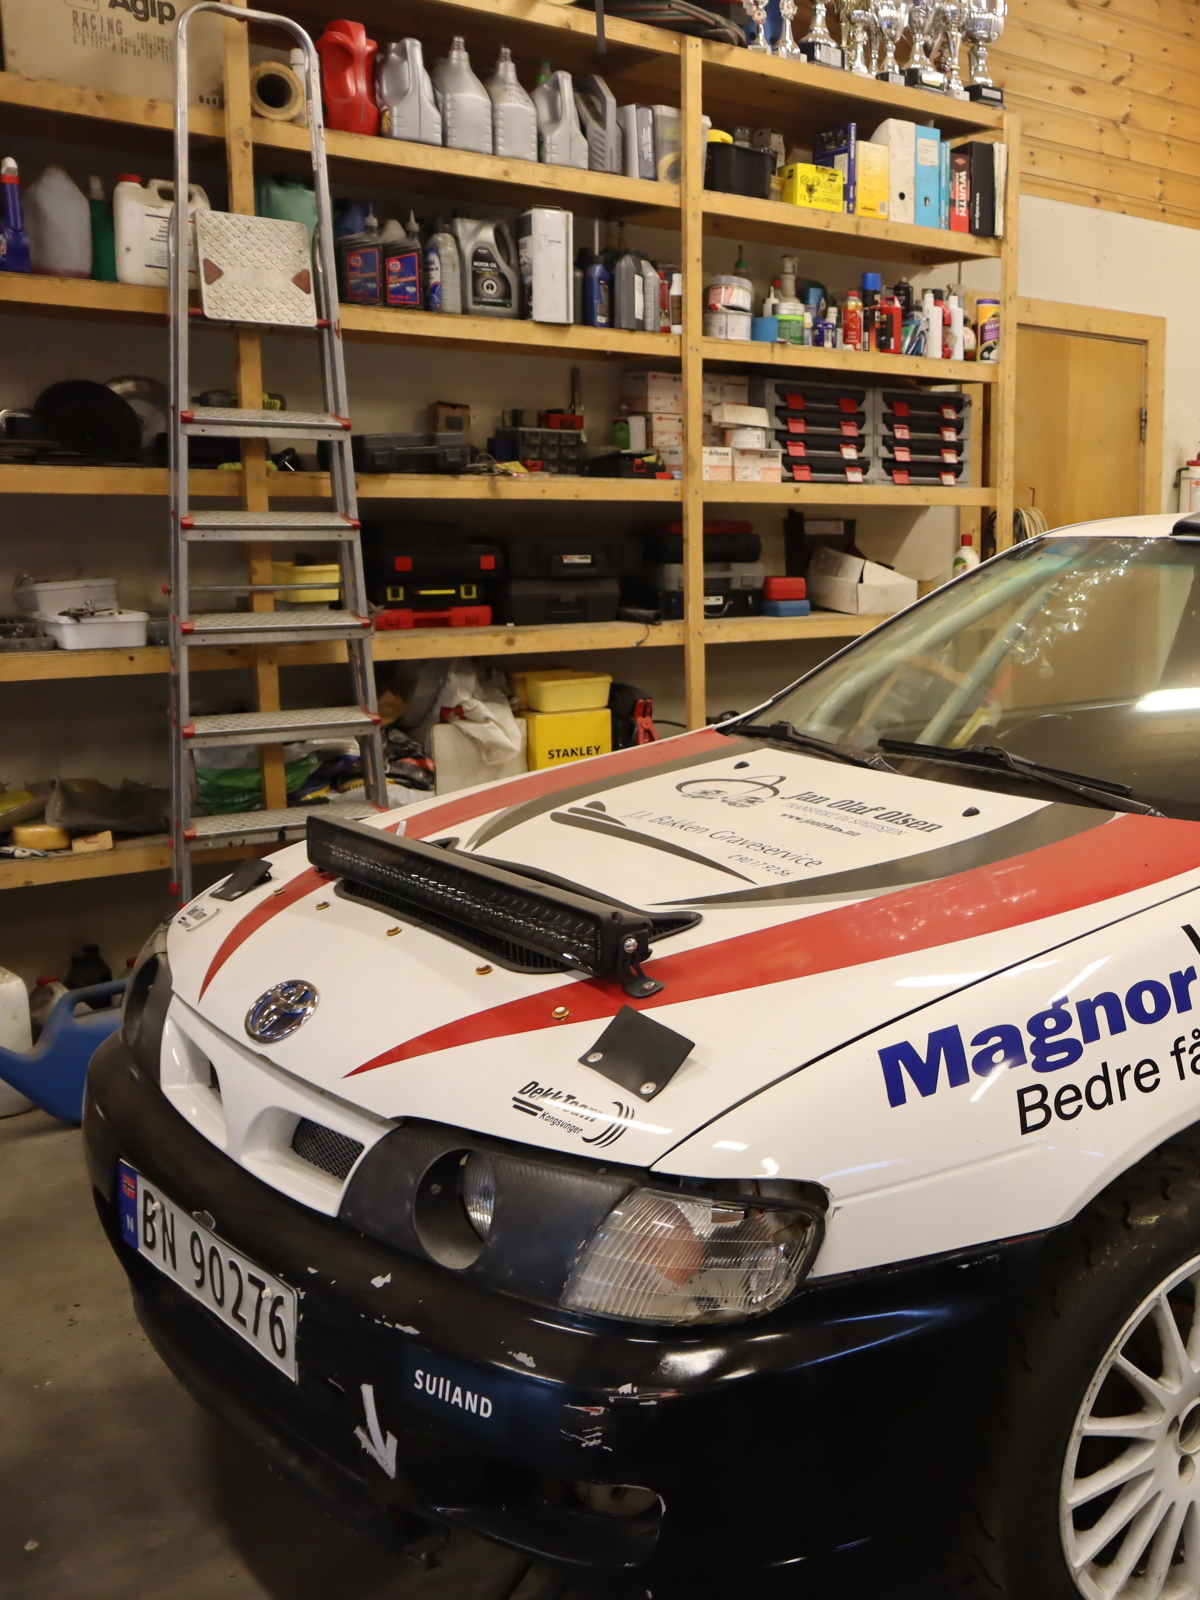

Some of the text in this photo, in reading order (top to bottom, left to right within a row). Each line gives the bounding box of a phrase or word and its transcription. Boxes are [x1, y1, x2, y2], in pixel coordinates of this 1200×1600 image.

[72, 9, 123, 36] RACING
[109, 0, 176, 25] Agip
[390, 262, 399, 270] 76
[708, 449, 729, 457] Arizona
[547, 744, 602, 760] STANLEY
[779, 790, 944, 833] Jan Olaf Olsen
[648, 815, 709, 834] Bakken
[708, 830, 823, 868] Graveservice
[1015, 1057, 1161, 1136] Bedre
[539, 1110, 583, 1135] Kongsvinger
[126, 1213, 135, 1234] N
[142, 1188, 287, 1359] BN 90276
